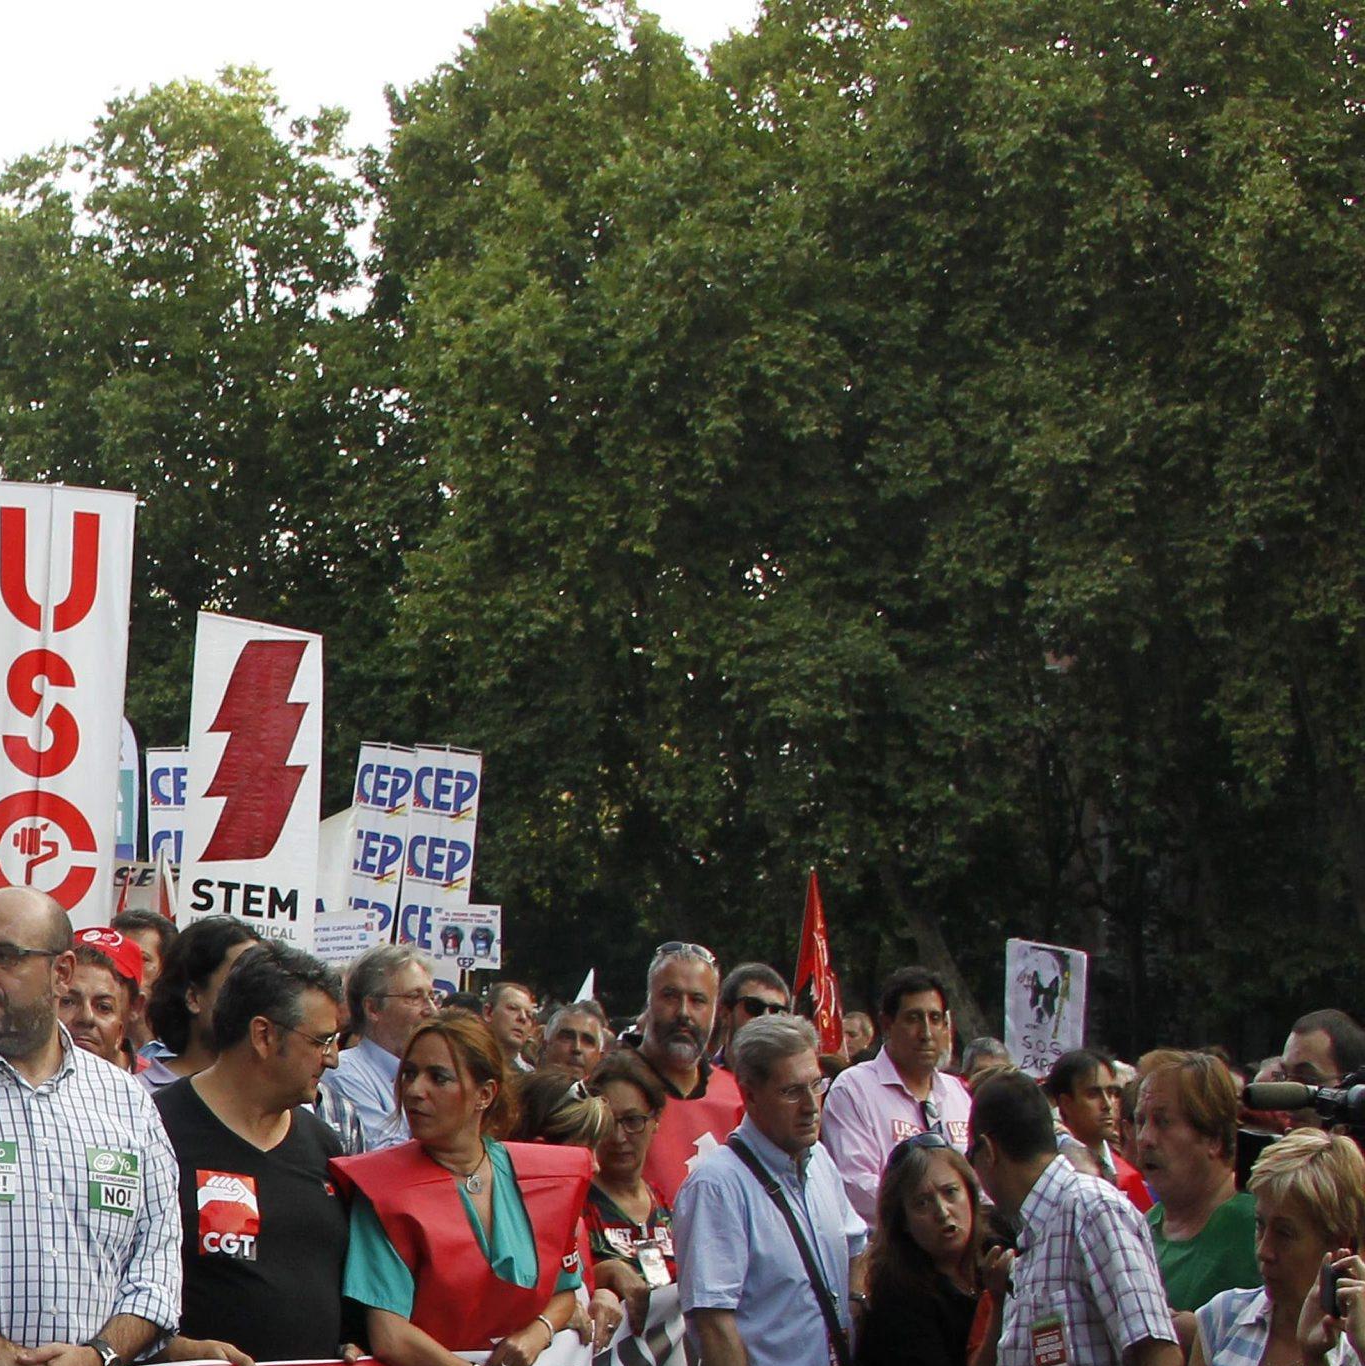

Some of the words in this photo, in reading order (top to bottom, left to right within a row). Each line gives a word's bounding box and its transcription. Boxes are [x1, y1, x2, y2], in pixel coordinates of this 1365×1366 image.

[150, 767, 188, 806] CE
[355, 763, 413, 808] CEP
[413, 766, 478, 813] CEP
[406, 835, 472, 881] CEP
[190, 878, 299, 921] STEM
[203, 1231, 255, 1257] CGT
